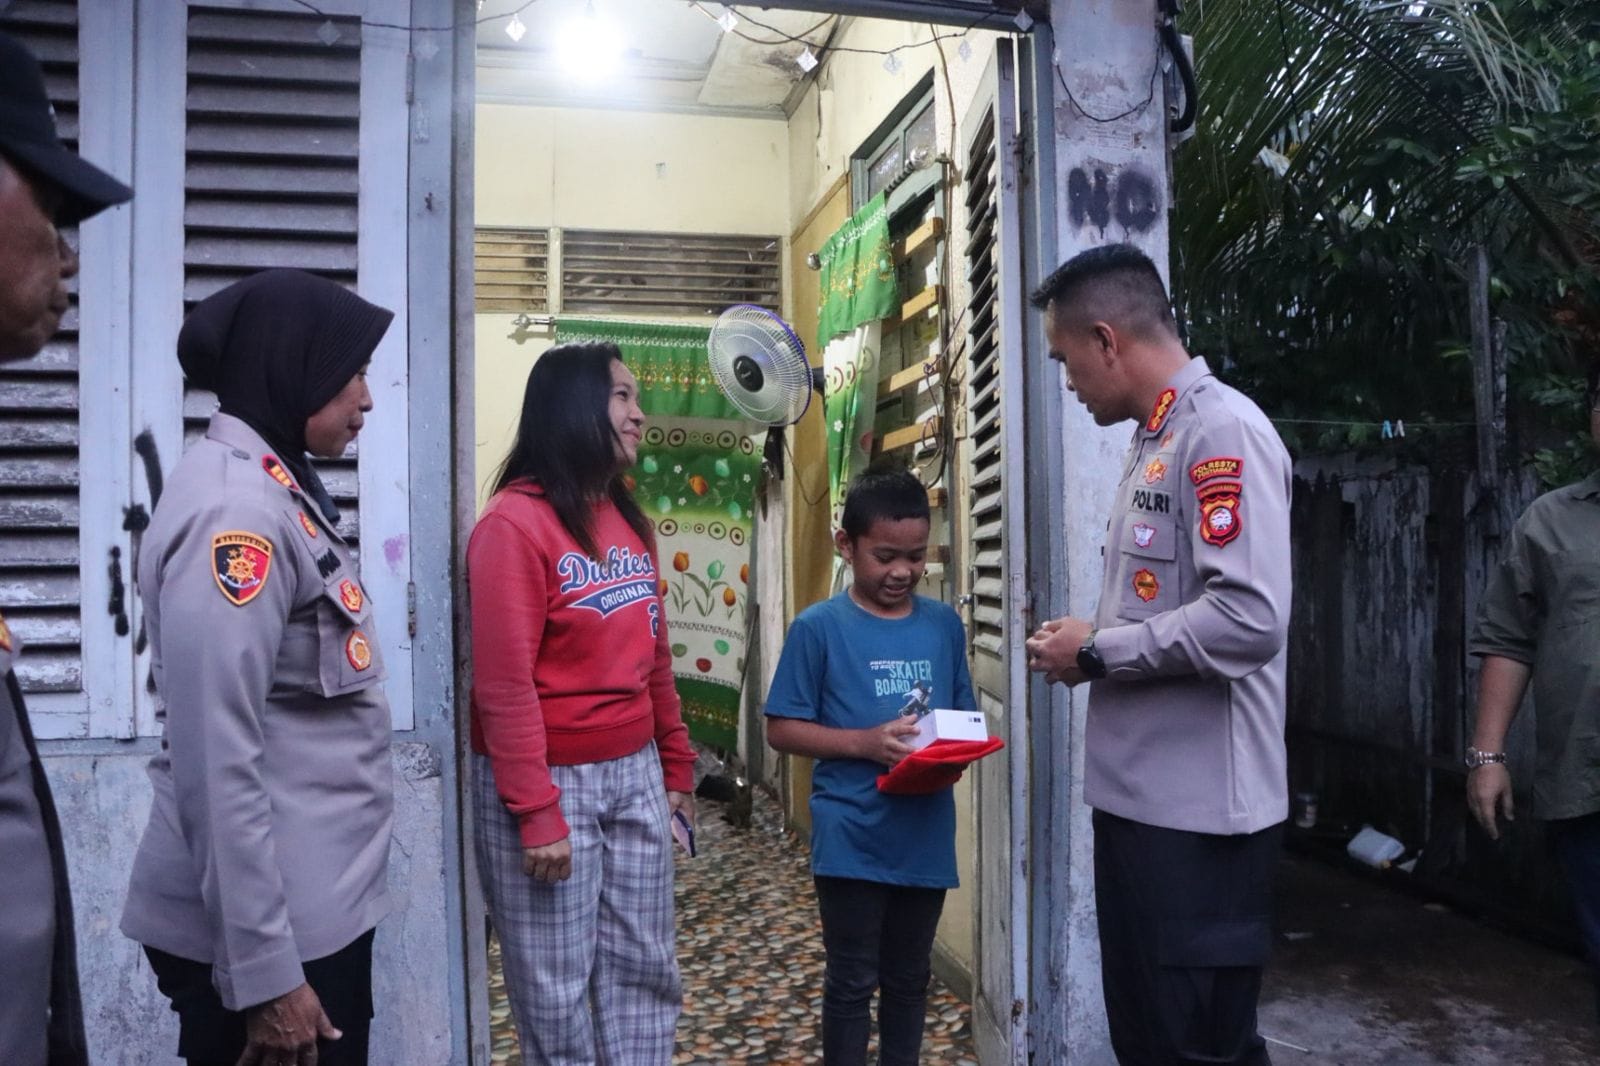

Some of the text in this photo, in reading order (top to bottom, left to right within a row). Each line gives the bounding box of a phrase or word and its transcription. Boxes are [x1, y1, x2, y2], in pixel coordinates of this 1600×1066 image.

[1193, 460, 1238, 475] POLRESTA
[1132, 489, 1169, 514] POLRI
[558, 546, 655, 594] Dickies
[601, 583, 652, 609] ORIGINAL
[889, 660, 932, 681] SKATER
[875, 678, 910, 697] BOARD
